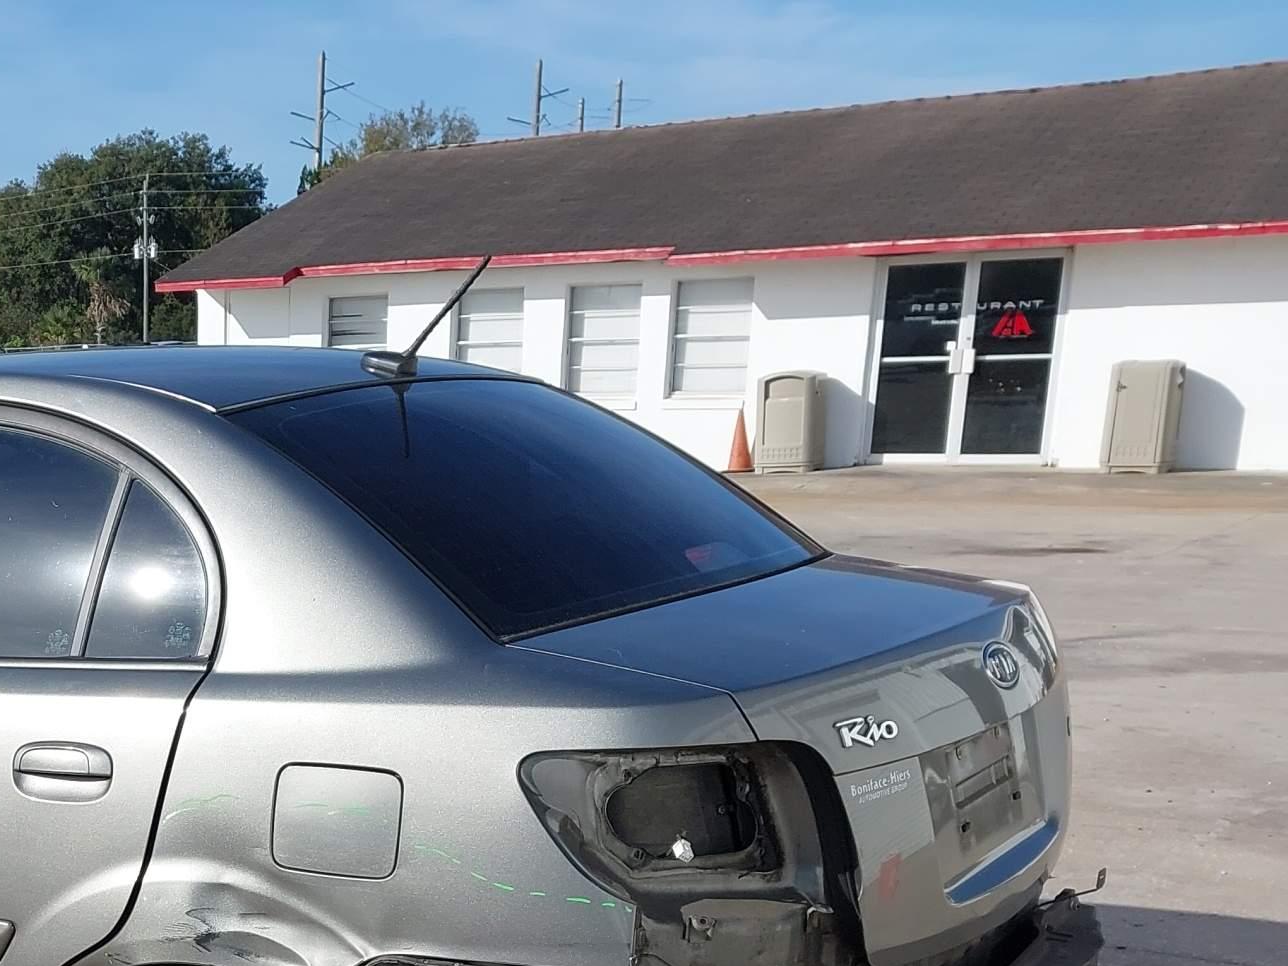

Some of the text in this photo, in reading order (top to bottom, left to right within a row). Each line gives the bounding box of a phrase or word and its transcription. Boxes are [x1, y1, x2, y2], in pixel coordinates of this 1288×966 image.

[911, 299, 1044, 312] RESTURANT
[834, 714, 899, 749] Rio
[850, 768, 911, 798] Boniface-Hiers
